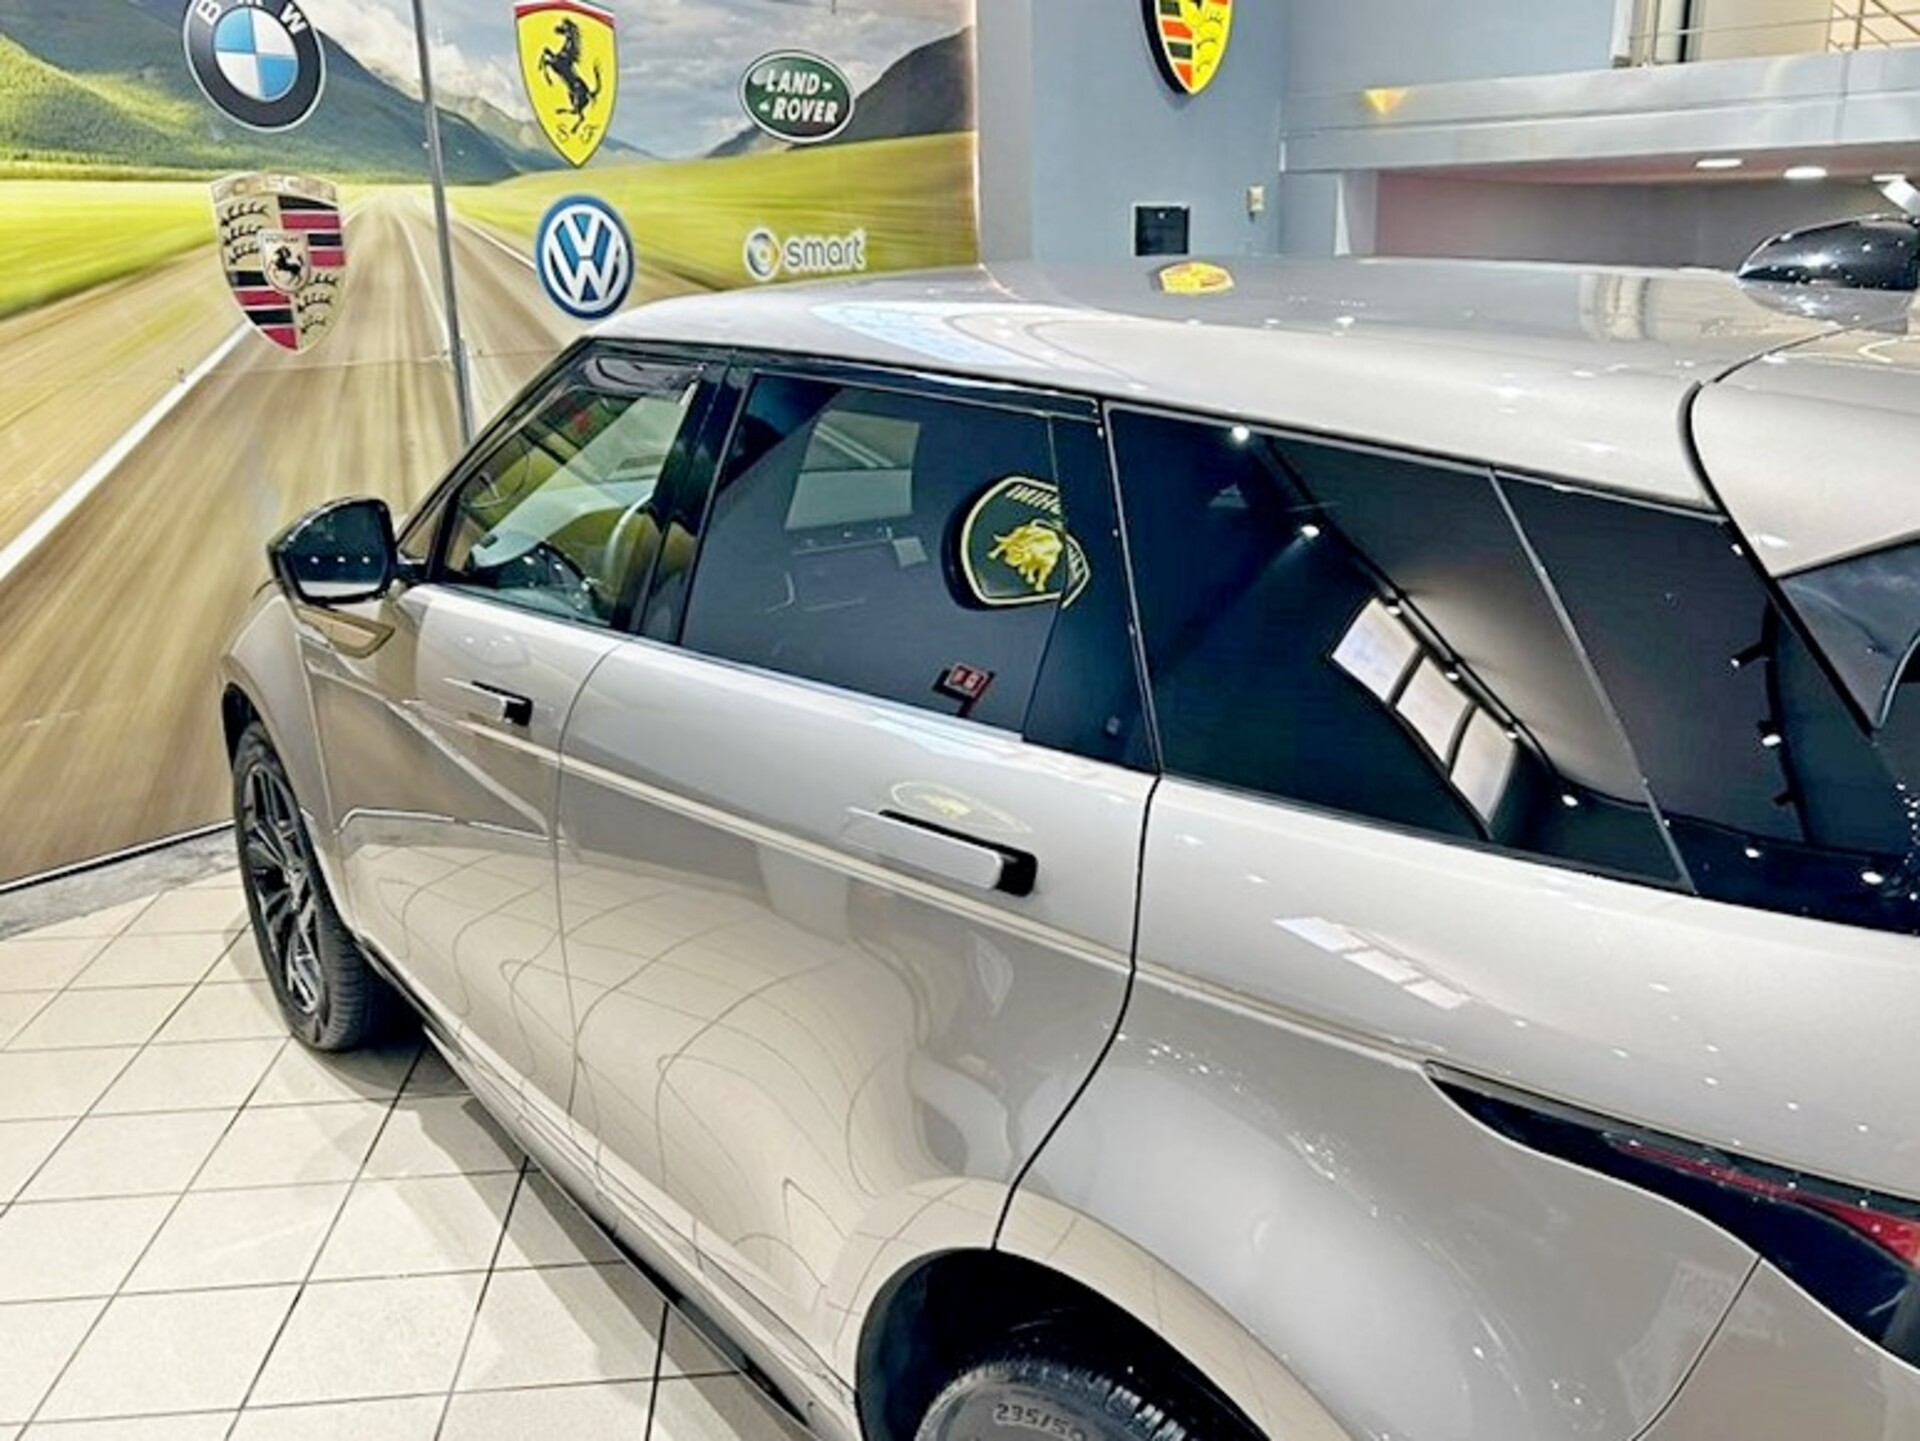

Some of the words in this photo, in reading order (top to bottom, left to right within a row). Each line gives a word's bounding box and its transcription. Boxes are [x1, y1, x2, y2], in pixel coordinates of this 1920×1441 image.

[765, 69, 820, 95] LAND
[772, 97, 839, 124] ROVER
[786, 234, 864, 268] smart
